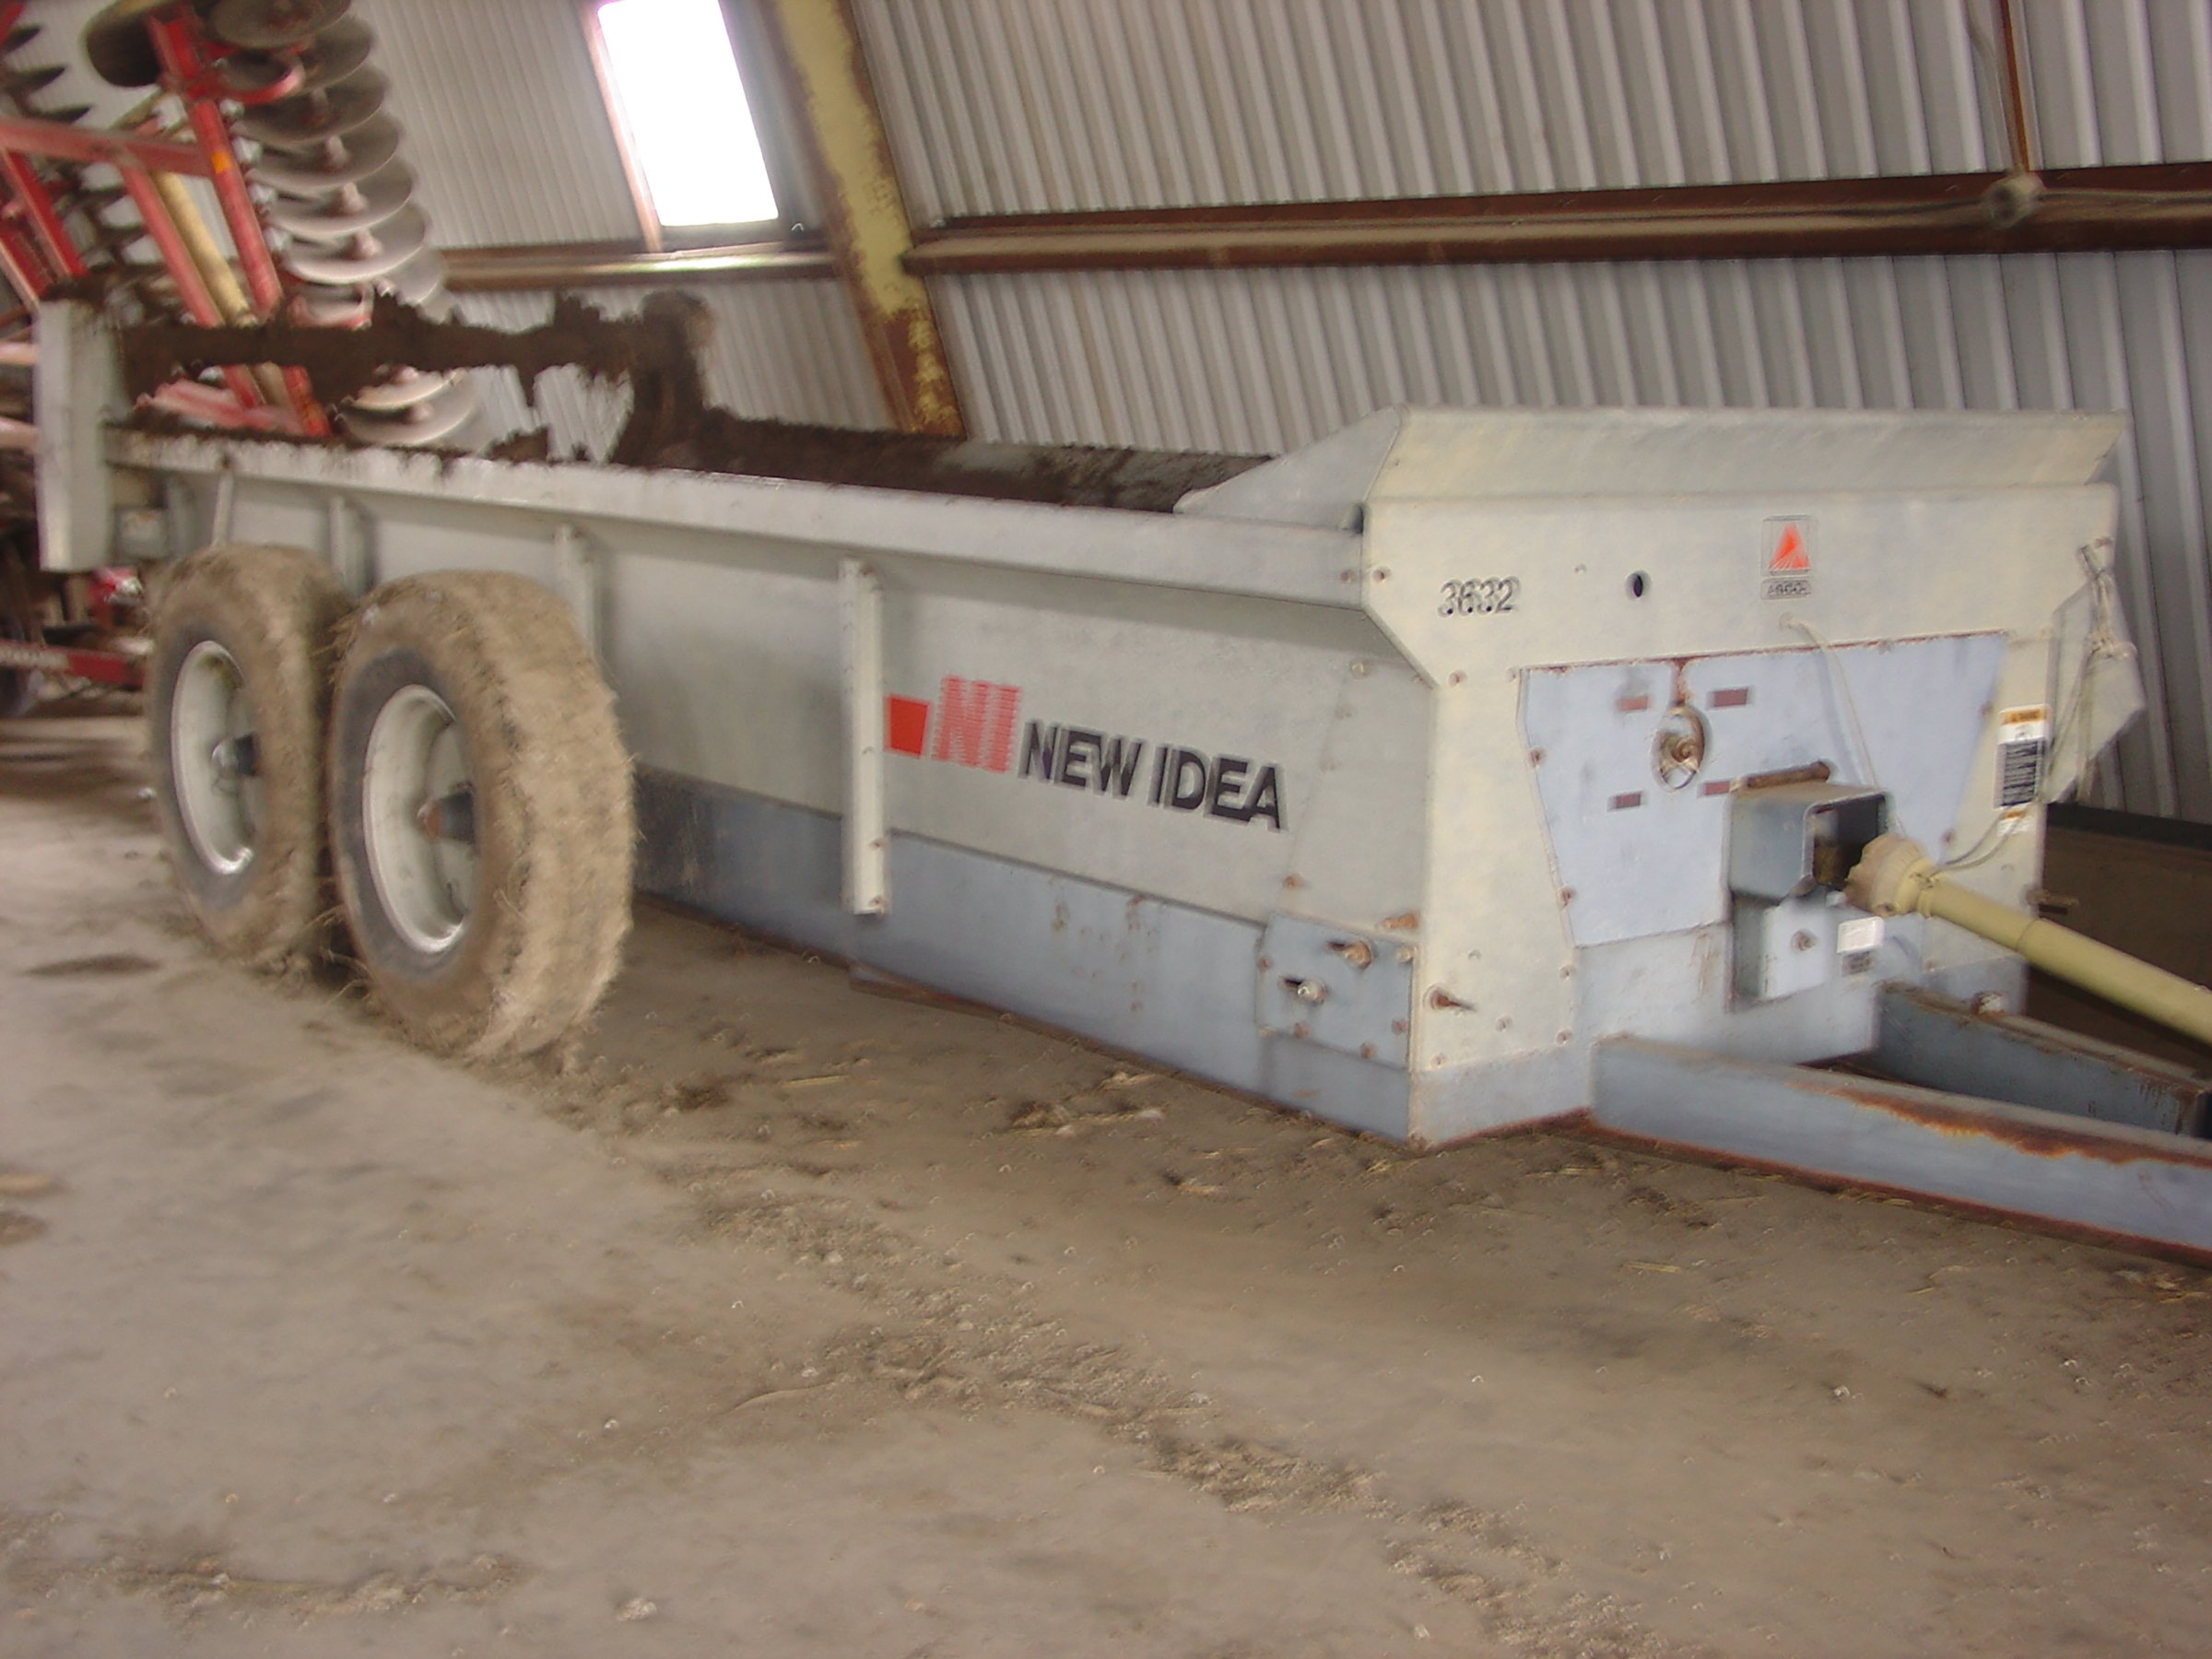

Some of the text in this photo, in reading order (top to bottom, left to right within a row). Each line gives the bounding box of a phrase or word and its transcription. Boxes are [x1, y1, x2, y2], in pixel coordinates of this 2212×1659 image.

[1438, 576, 1521, 618] 3632
[1018, 719, 1288, 831] NEW IDEA
